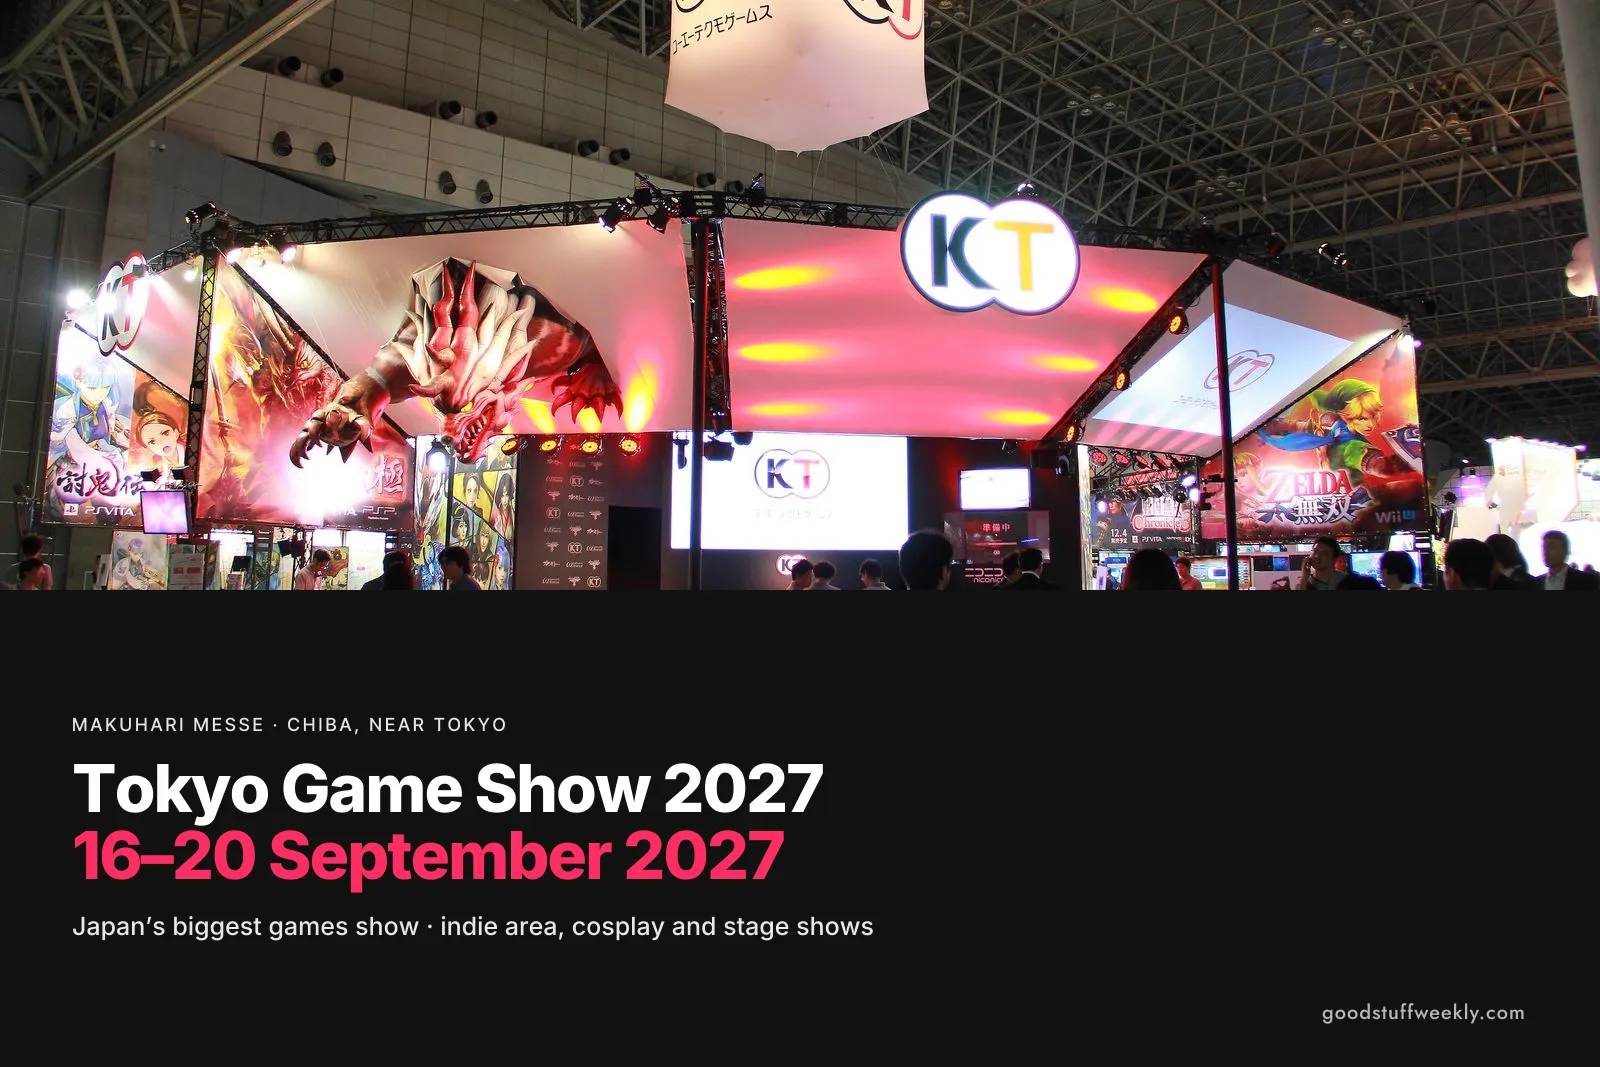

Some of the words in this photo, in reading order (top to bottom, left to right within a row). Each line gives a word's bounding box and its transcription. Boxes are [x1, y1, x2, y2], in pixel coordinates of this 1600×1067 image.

[672, 5, 773, 55] コーエーテクモゲームス
[930, 213, 1055, 291] KT
[766, 458, 820, 489] KT
[1262, 469, 1353, 503] ZELDA
[362, 505, 396, 515] PSP
[1293, 494, 1357, 525] 無双
[1375, 511, 1400, 524] Wii
[1402, 510, 1416, 520] U
[982, 523, 1010, 532] 準備中
[1110, 529, 1128, 537] 12.4
